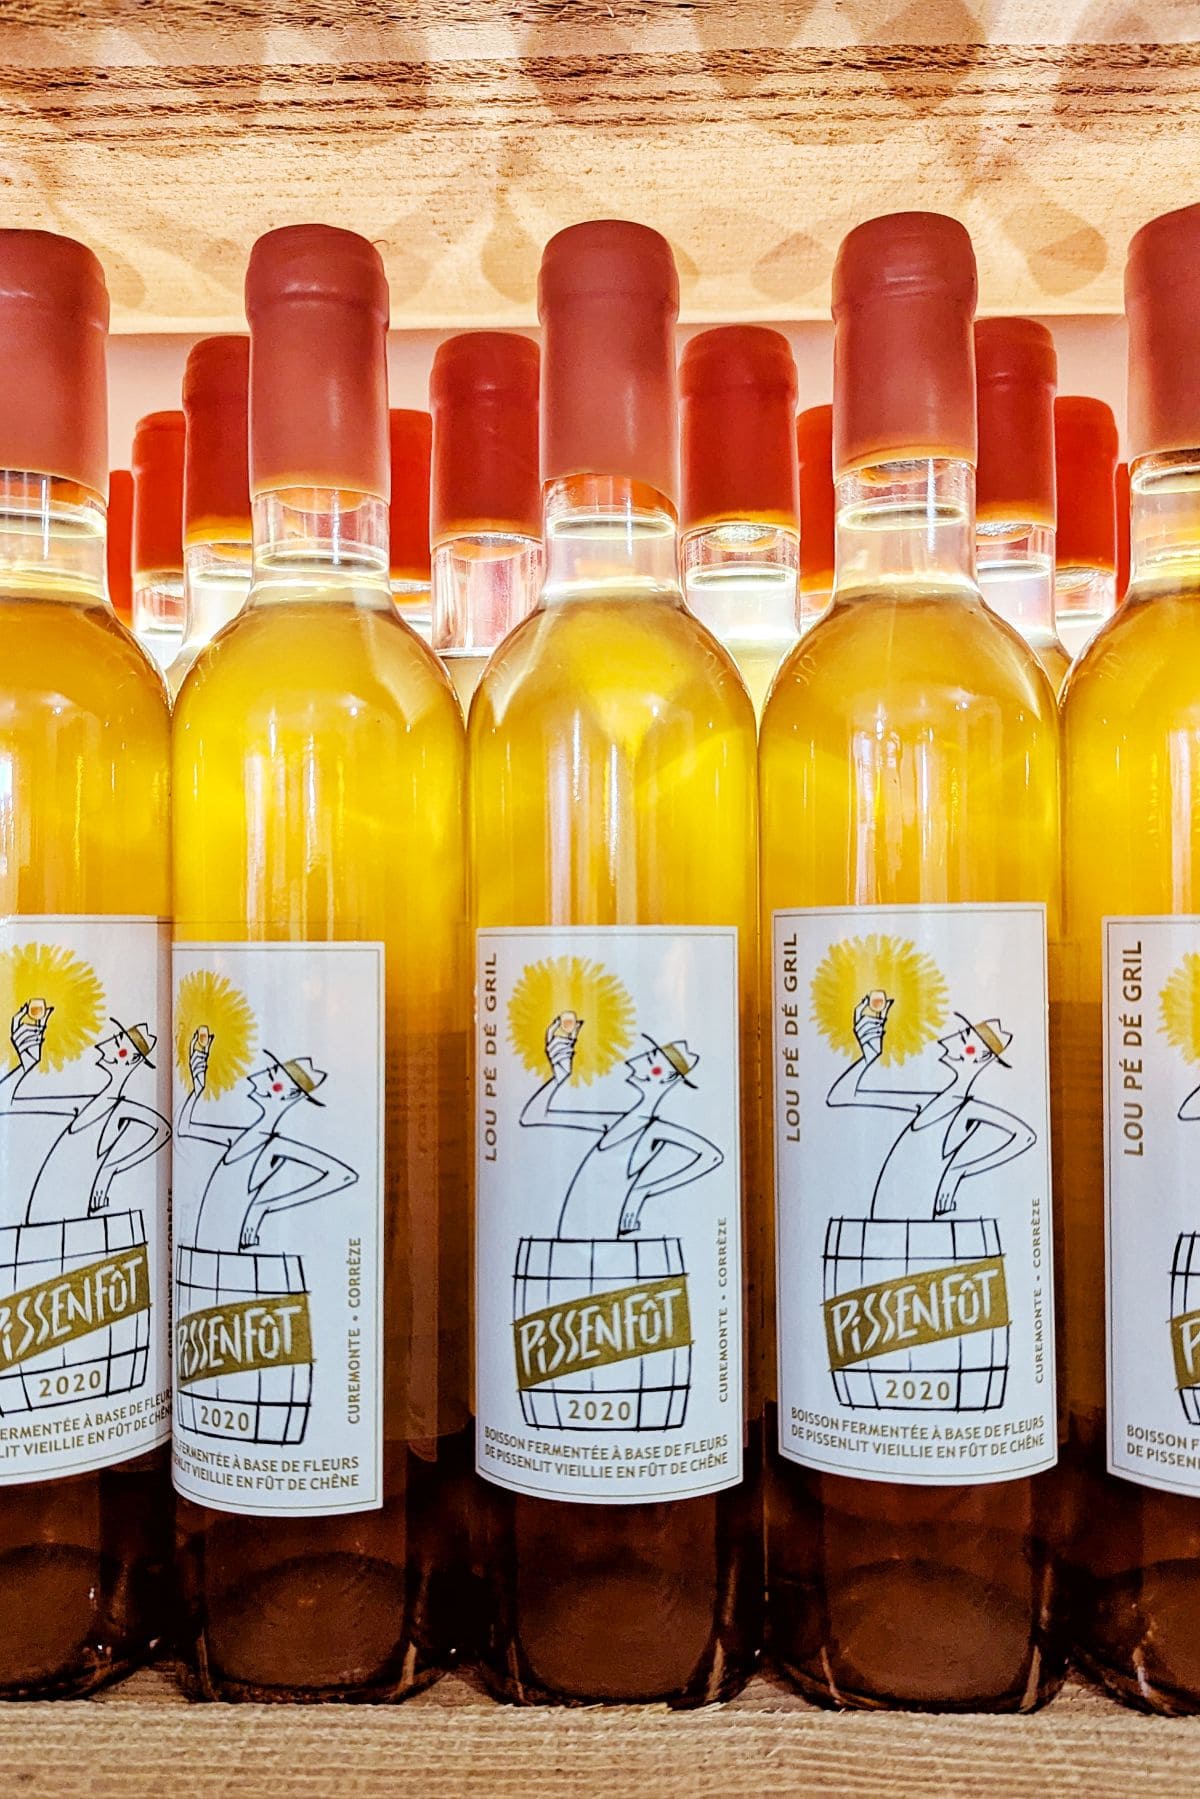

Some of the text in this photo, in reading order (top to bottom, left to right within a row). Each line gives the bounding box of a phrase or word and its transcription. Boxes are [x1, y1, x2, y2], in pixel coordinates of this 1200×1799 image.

[781, 932, 801, 1143] LOU PÉ DÉ GRIL
[1118, 940, 1144, 1157] LOU PÉ DÉ GRIL
[483, 952, 498, 1163] LOU PÉ DÉ GRIL
[1030, 1197, 1043, 1384] CUREMONTE CORRÈZE
[716, 1216, 728, 1404] CUREMONTE CORRÈZE
[346, 1237, 361, 1425] CUREMONTE CORRÈZE
[39, 1370, 101, 1398] 2020
[885, 1379, 950, 1401] 2020
[0, 1416, 80, 1441] ERMENTÉE
[83, 1413, 93, 1429] À
[95, 1406, 127, 1426] BASE
[129, 1403, 143, 1417] DE
[200, 1405, 249, 1431] 2020
[568, 1399, 631, 1421] 2020
[791, 1406, 1045, 1441] BOISSON FERMENTÉE À BASE DE FLEURS
[23, 1434, 85, 1456] VIEILLIE
[88, 1429, 105, 1445] EN
[108, 1422, 132, 1440] FÛT
[134, 1419, 148, 1432] DE
[484, 1425, 728, 1461] BOISSON FERMENTÉE À BASE DE FLEURS
[791, 1425, 1045, 1459] DE PISSENLIT VIEILLIE EN FÛT DE CHÊNE
[1126, 1424, 1187, 1450] BOISSON
[232, 1454, 242, 1469] À
[244, 1458, 278, 1473] BASE
[281, 1459, 300, 1473] DE
[303, 1456, 360, 1473] FLEURS
[484, 1443, 728, 1479] DE PISSENLIT VIEILLIE EN FÛT DE CHÊNE
[1126, 1441, 1200, 1470] DE PISSEN
[192, 1464, 360, 1491] VIEILLIE EN FÛT DE CHÊNE
